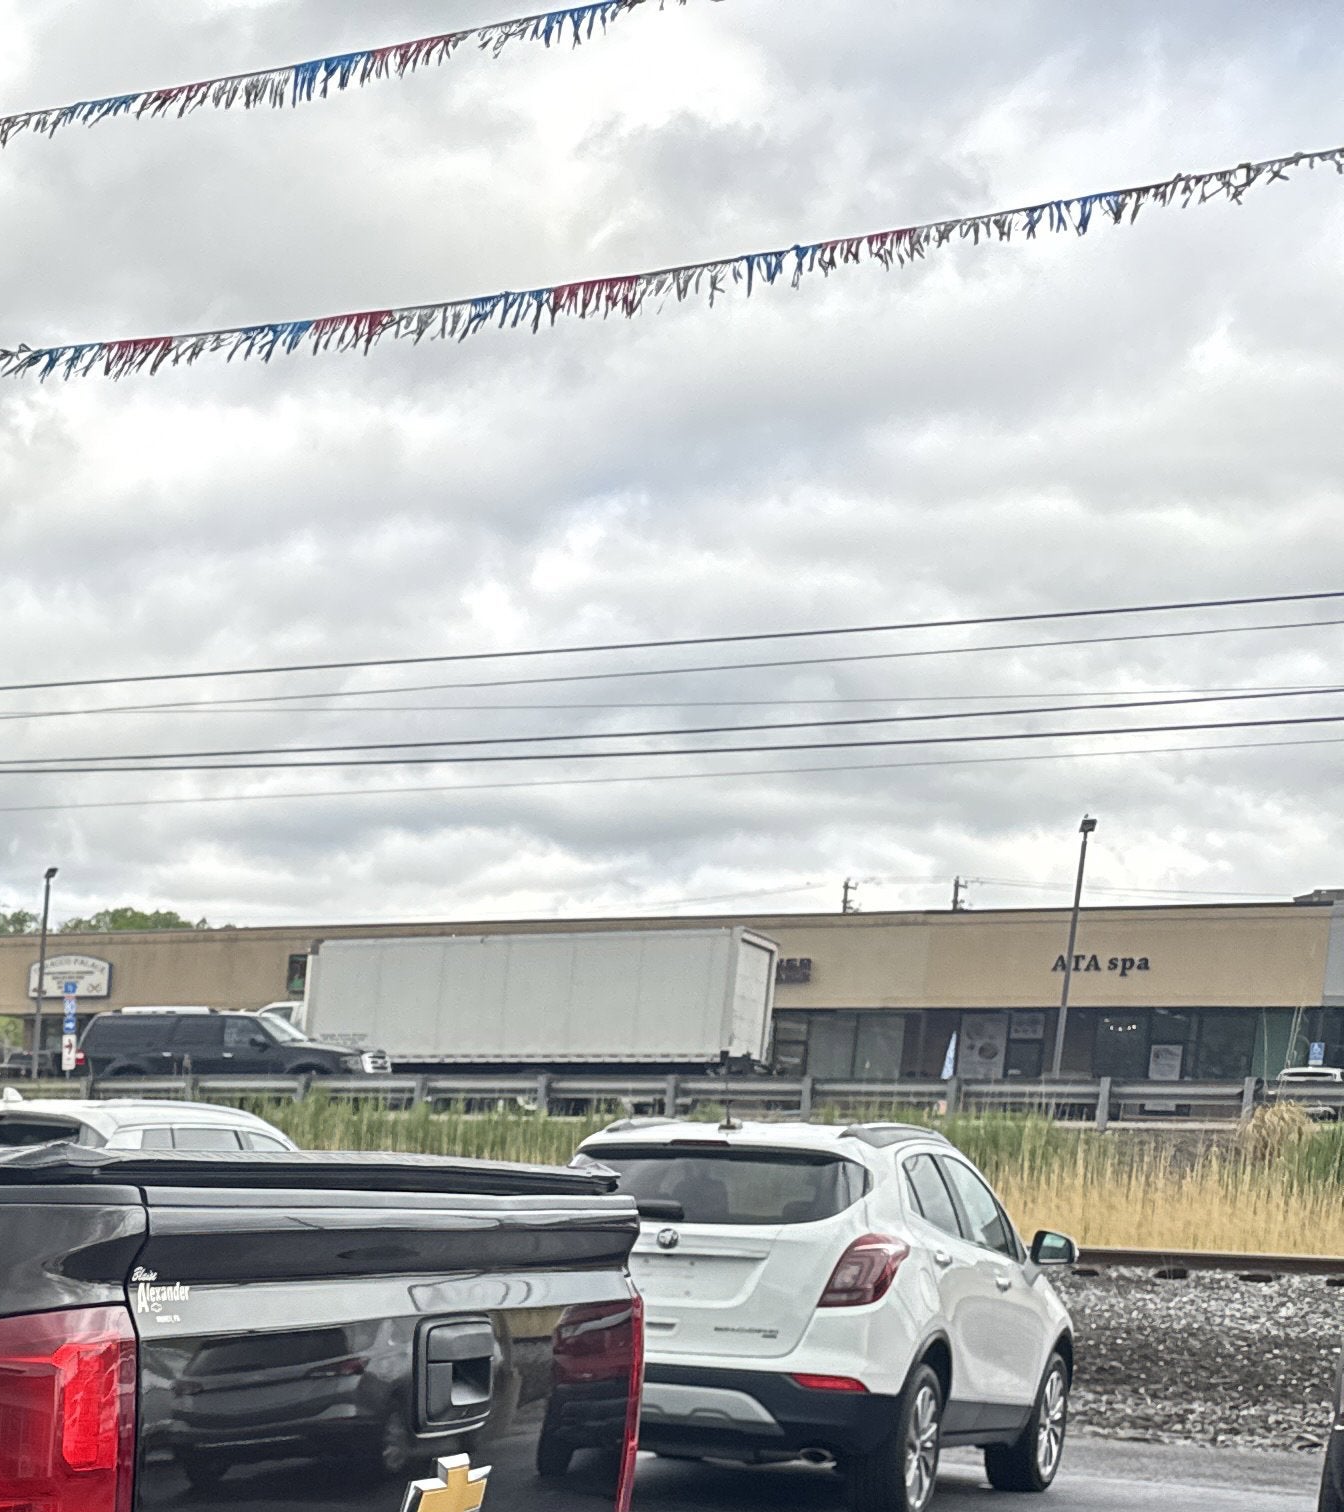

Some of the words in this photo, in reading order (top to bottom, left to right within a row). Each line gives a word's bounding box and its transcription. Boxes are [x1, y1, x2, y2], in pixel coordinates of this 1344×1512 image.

[1051, 954, 1101, 972] ATA
[1107, 956, 1150, 977] spa
[137, 1281, 191, 1314] Alexander
